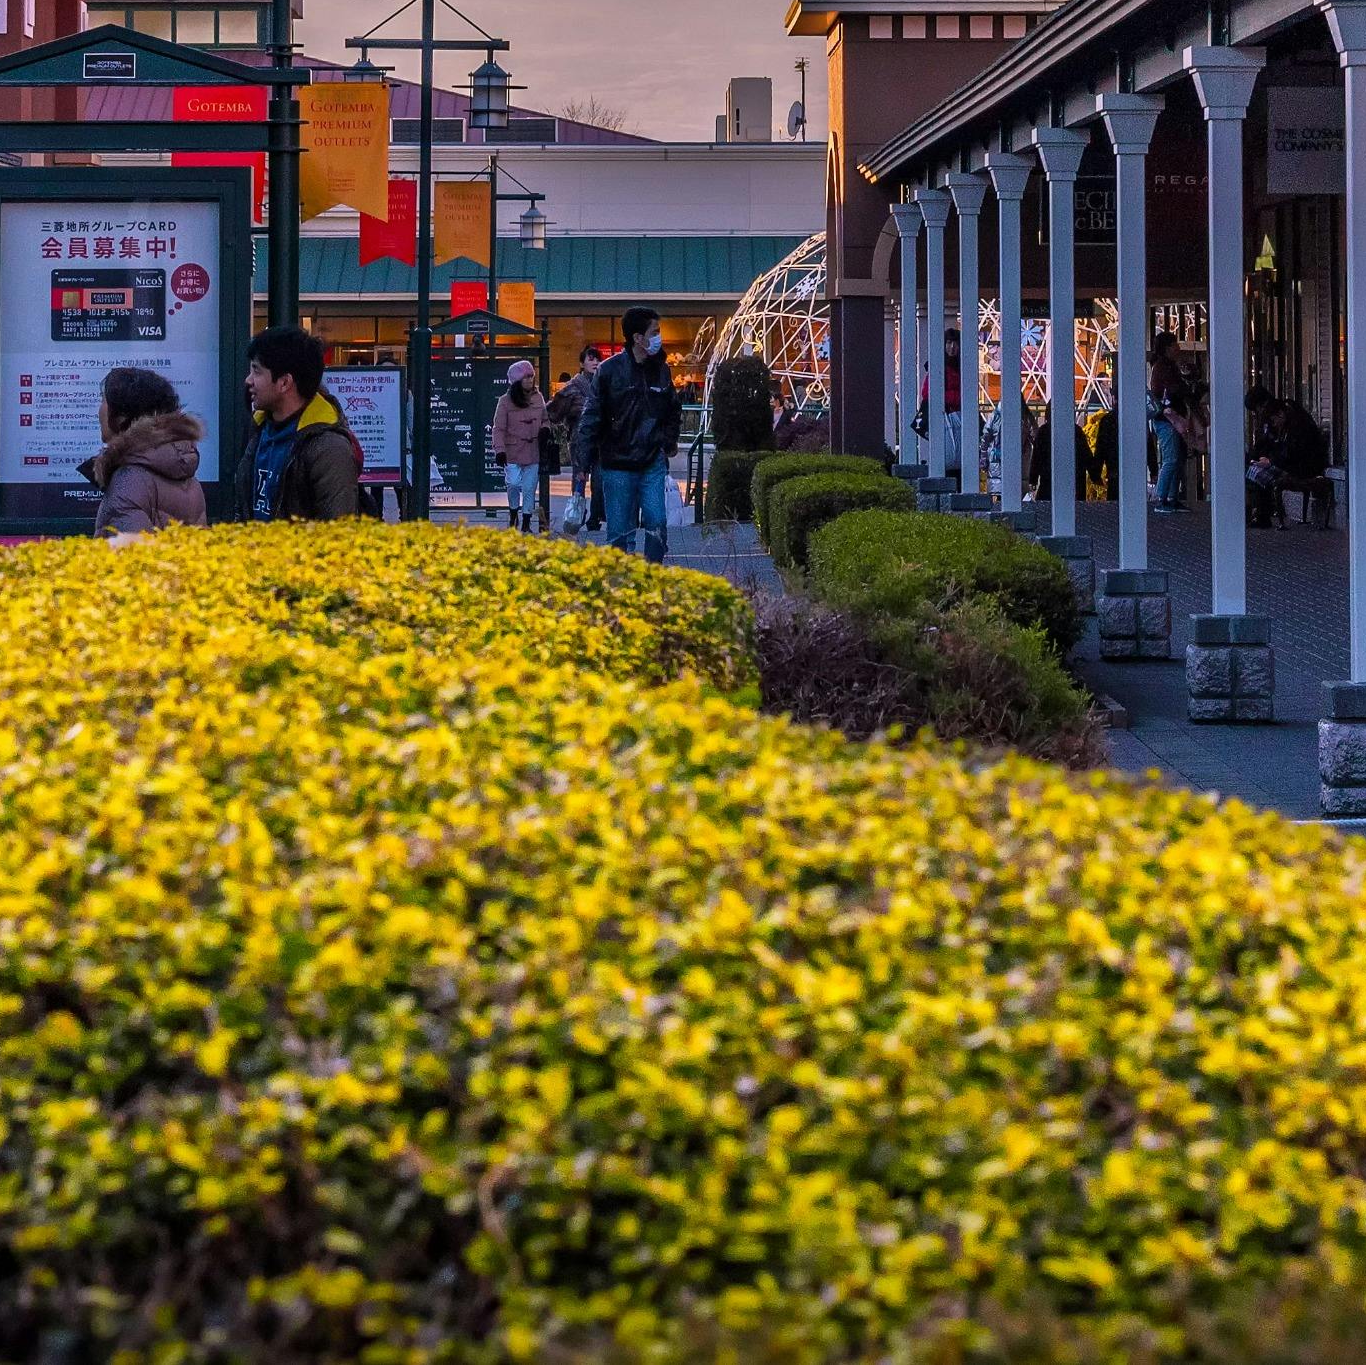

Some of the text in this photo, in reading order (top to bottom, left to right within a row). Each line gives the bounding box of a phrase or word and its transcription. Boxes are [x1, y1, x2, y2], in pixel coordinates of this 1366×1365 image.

[313, 121, 371, 130] PREMIUM
[314, 137, 370, 147] OUTLETS
[1155, 175, 1209, 185] REGA
[41, 221, 177, 232] 三菱地所グループCARD
[41, 236, 176, 259] 会員募集中!
[180, 278, 200, 286] お得に
[62, 308, 154, 316] 4538 7012 3456 7890
[138, 326, 162, 336] VISA
